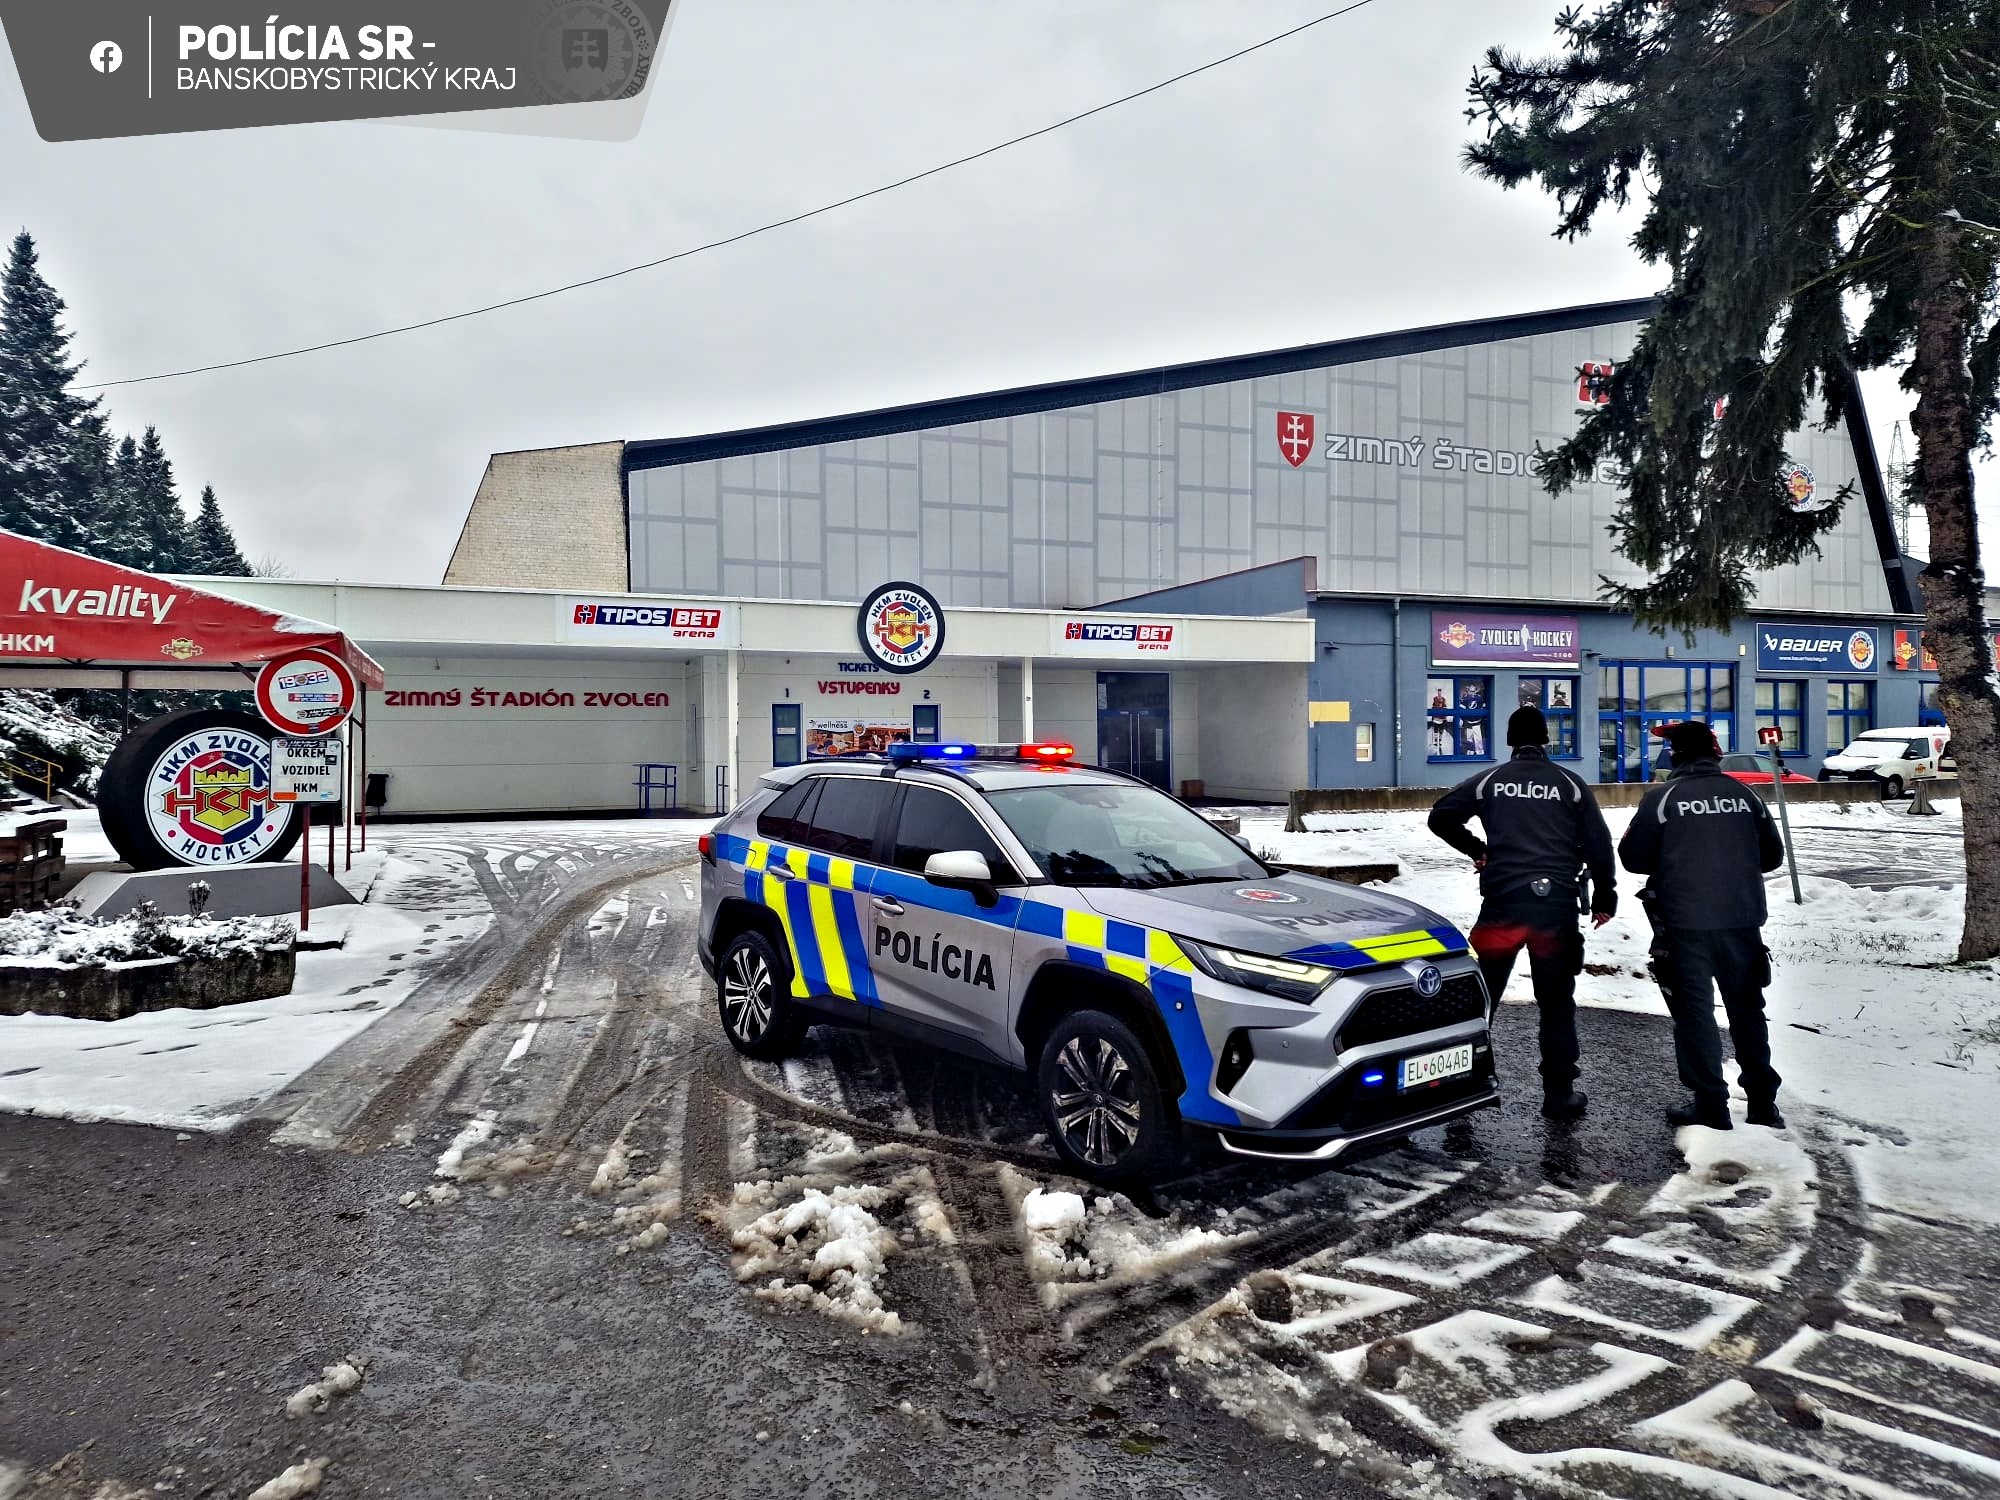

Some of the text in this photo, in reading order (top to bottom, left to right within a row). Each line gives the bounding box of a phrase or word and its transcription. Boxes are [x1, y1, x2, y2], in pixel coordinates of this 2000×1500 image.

[1325, 433, 1425, 467] ZIMNÝ
[1433, 438, 1556, 477] ŠTADIÓ
[18, 580, 176, 624] kvality
[871, 593, 933, 620] HKM ZVOLEN
[602, 608, 718, 626] TIPOS BET
[673, 630, 715, 638] arena
[1085, 625, 1171, 640] TIPOS BET
[1480, 629, 1573, 647] ZVOLEN HOCKEY
[0, 633, 55, 653] HKM
[1137, 642, 1169, 650] arena
[1779, 638, 1843, 653] BAUER
[882, 649, 923, 663] HOCKEY
[838, 662, 880, 673] TICKETS
[785, 688, 790, 698] 1
[817, 681, 900, 695] VSTUPENKY
[923, 690, 930, 699] 2
[384, 687, 669, 706] ZIMNÝ ŠTADIÓN ZVOLEN
[817, 721, 848, 729] wellness
[1764, 731, 1778, 744] H
[159, 735, 270, 782] HKM ZVOLE
[287, 748, 326, 758] OKREM
[282, 765, 331, 775] VOZIDIEL
[293, 783, 318, 792] HKM
[1494, 781, 1561, 801] POLÍCIA
[1677, 796, 1752, 817] POLÍCIA
[181, 834, 262, 861] HOCKEY
[874, 924, 997, 991] POLÍCIA
